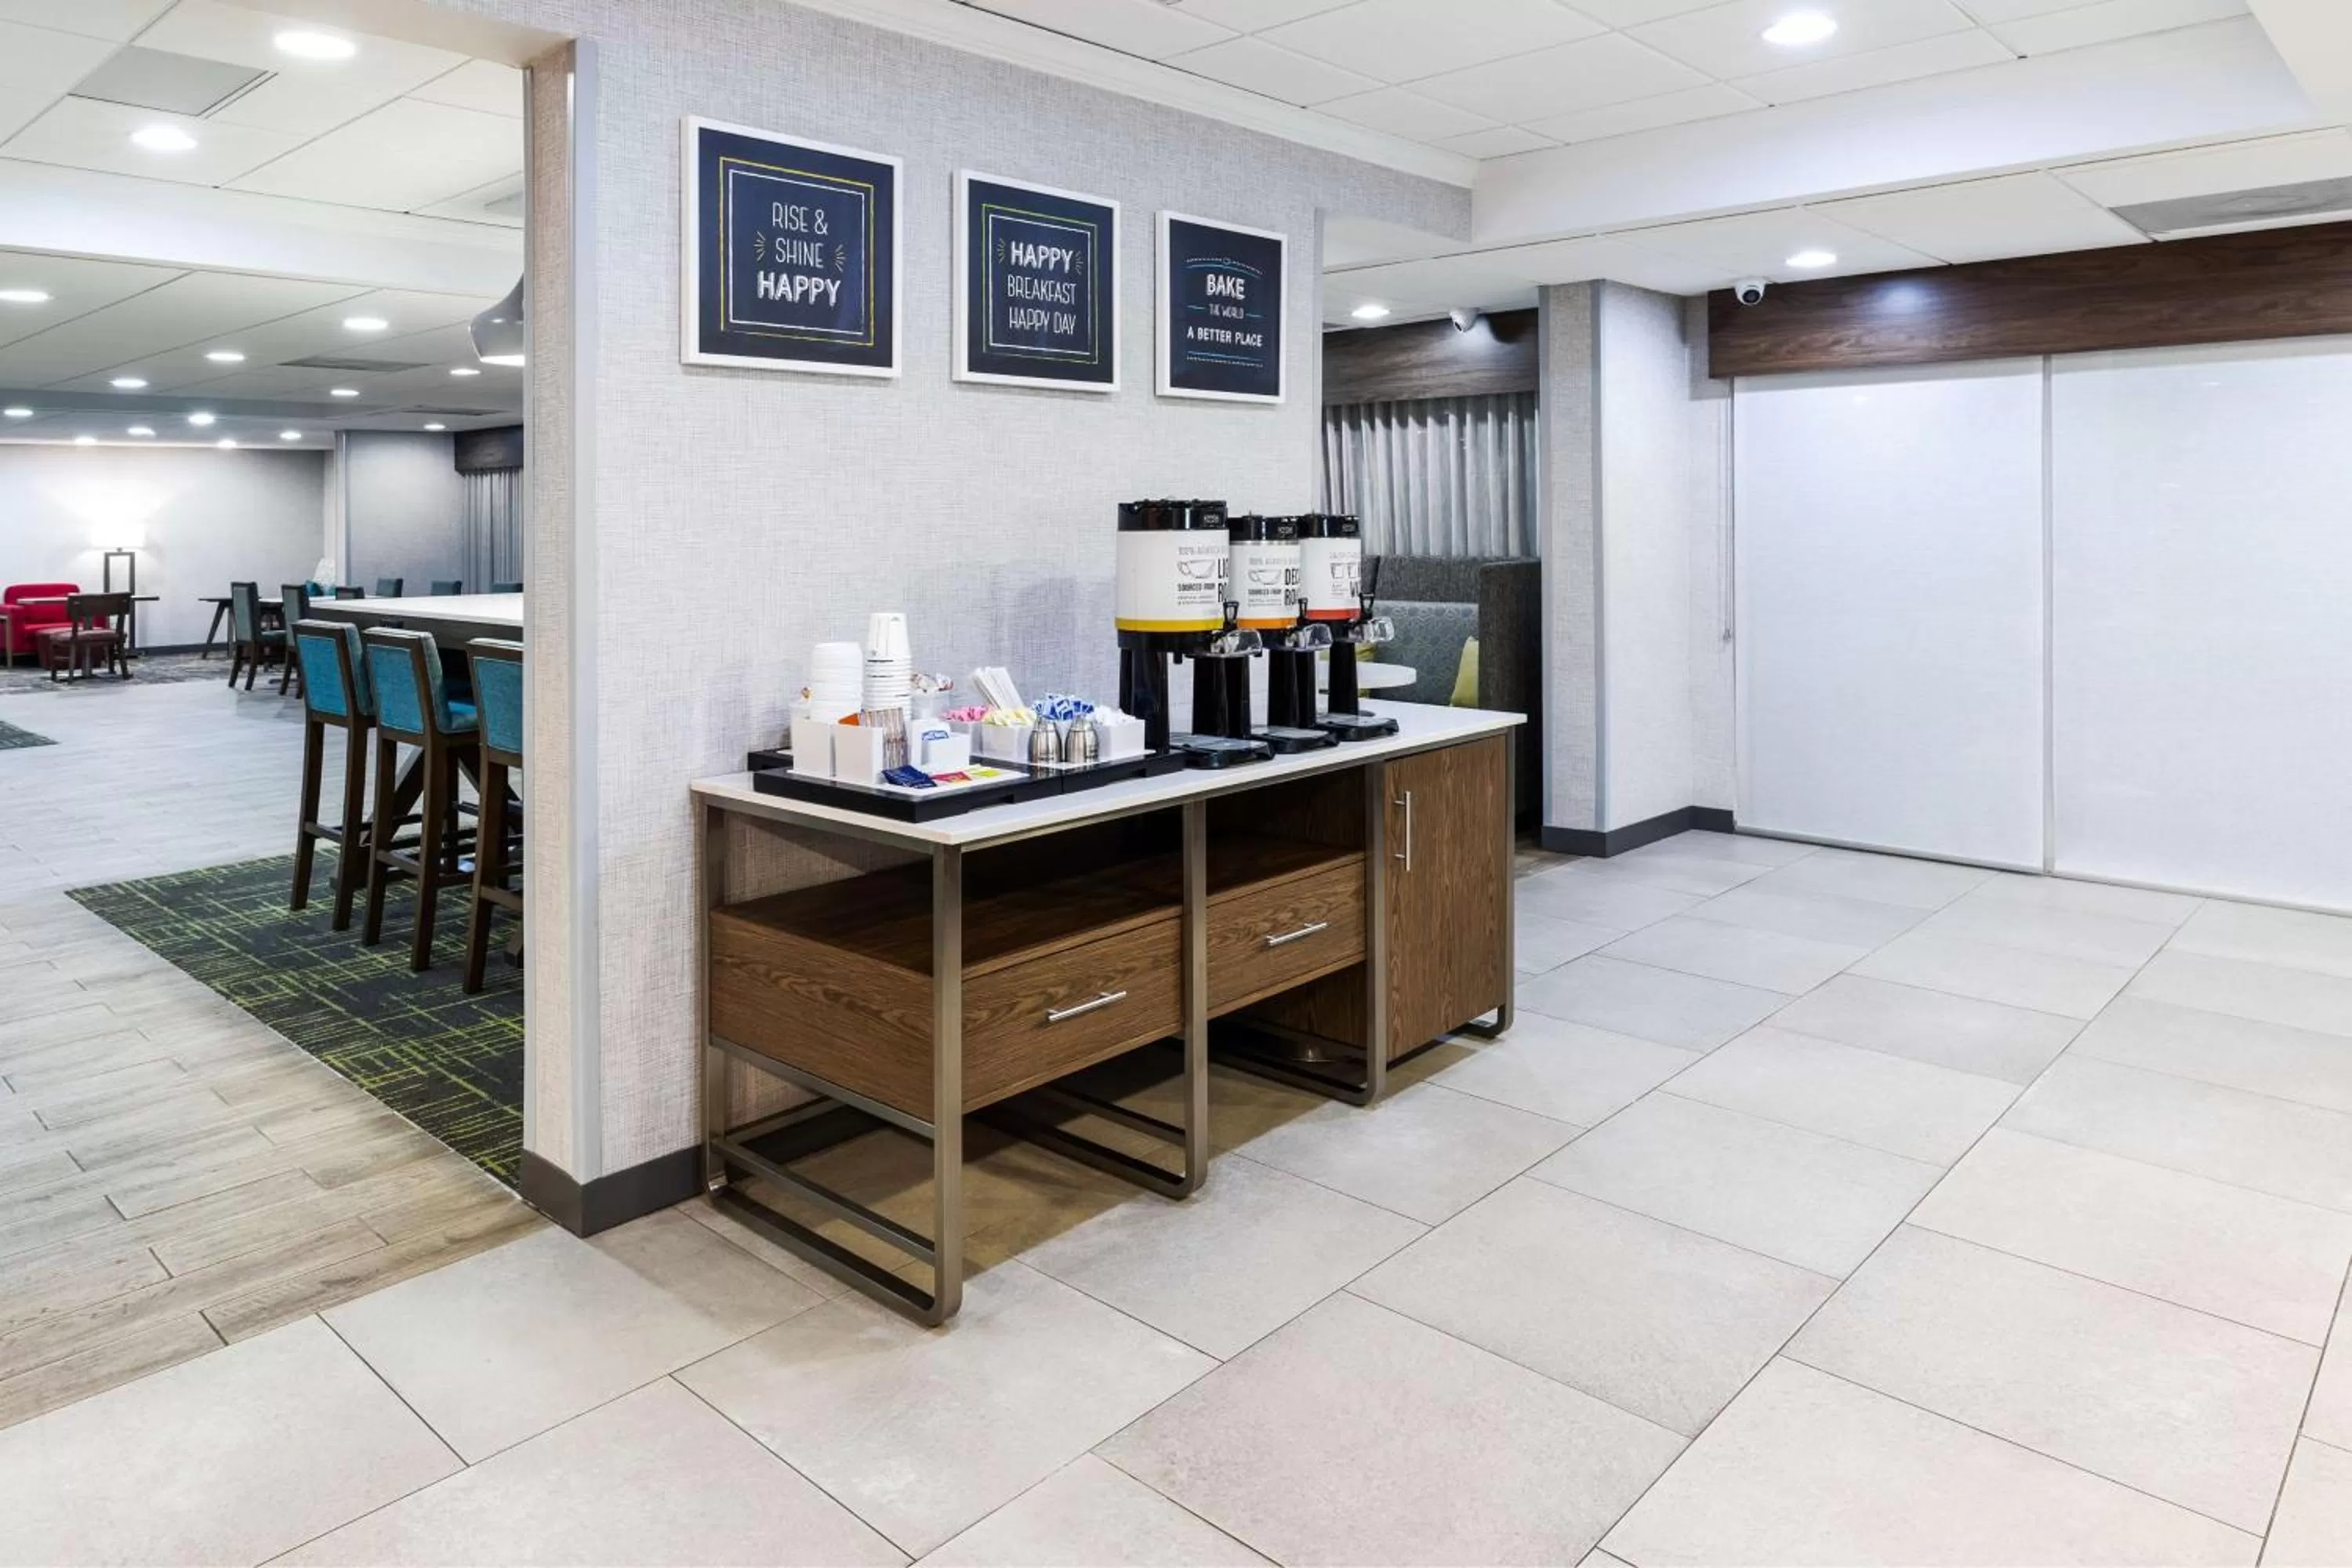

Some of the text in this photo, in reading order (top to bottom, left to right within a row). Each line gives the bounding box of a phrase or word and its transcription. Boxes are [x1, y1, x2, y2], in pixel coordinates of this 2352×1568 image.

[771, 201, 828, 235] RISE &
[775, 238, 824, 269] SHINE
[1011, 241, 1073, 273] HAPPY
[757, 270, 841, 307] HAPPY
[1007, 274, 1077, 305] BREAKFAST
[1206, 274, 1246, 299] BAKE
[1009, 307, 1076, 336] HAPPY DAY
[1221, 305, 1245, 319] WORLD
[1186, 326, 1263, 347] A BETTER PLACE
